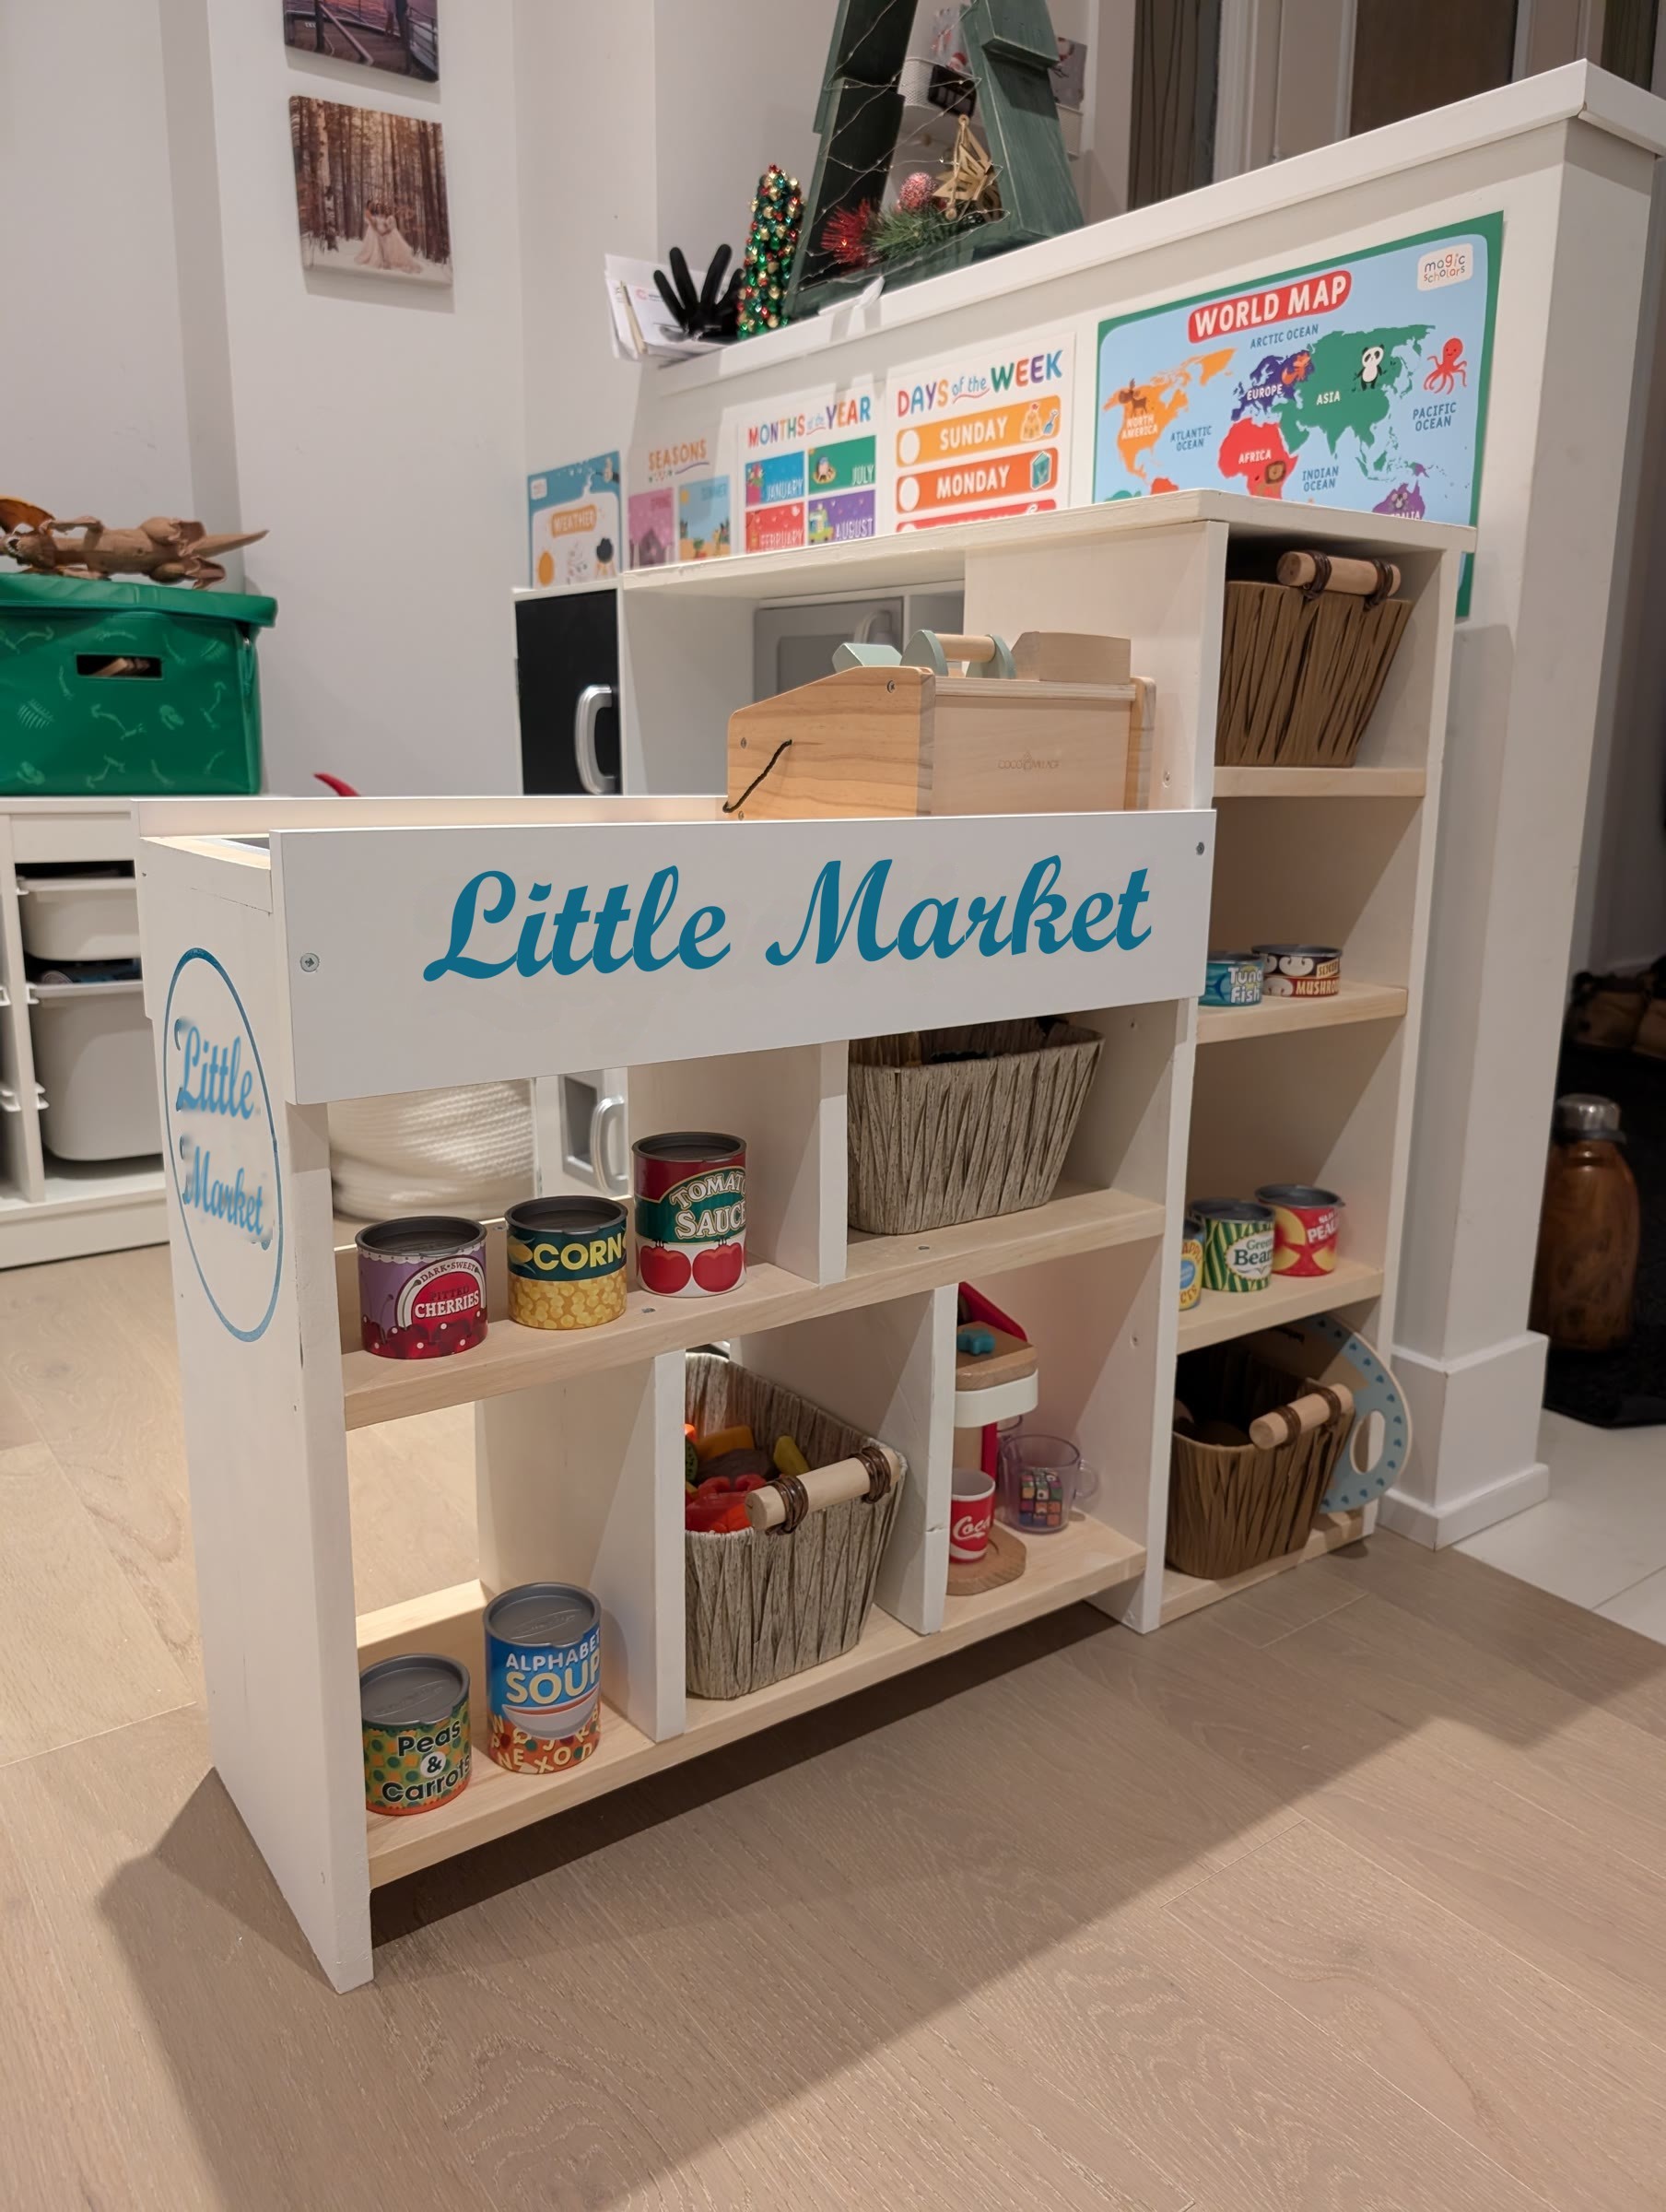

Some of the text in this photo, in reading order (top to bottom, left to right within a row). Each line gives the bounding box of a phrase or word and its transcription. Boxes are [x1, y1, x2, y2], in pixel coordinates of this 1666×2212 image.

[1425, 253, 1466, 273] magic
[1424, 265, 1465, 284] scholars
[1194, 275, 1347, 338] WORLD MAP
[1250, 324, 1319, 349] ARCTIC OCEAN
[897, 349, 1063, 418] DAYS of the WEEK
[1247, 383, 1284, 401] EUROPE
[1316, 390, 1341, 406] ASIA
[747, 414, 806, 448] MONTHS
[826, 395, 872, 429] YEAR
[1126, 414, 1156, 429] NORTH
[1413, 402, 1457, 420] PACIFIC
[938, 416, 1008, 452] SUNDAY
[1120, 424, 1158, 440] AMERICA
[1170, 425, 1213, 442] ATLANTIC
[1415, 415, 1452, 432] OCEAN
[649, 437, 708, 471] SEASONS
[1176, 438, 1205, 452] OCEAN
[1238, 449, 1272, 465] AFRICA
[851, 464, 875, 486] JULY
[936, 465, 1010, 499] MONDAY
[1302, 465, 1340, 482] INDIAN
[1303, 477, 1336, 492] OCEAN
[766, 478, 804, 502] JANUARY
[836, 517, 874, 540] AUGUST
[423, 854, 1153, 982] Little Market
[1230, 985, 1260, 1004] Fish
[181, 1025, 255, 1122] Little
[184, 1145, 264, 1236] Market
[533, 1232, 622, 1271] CORN
[420, 1261, 475, 1283] DARK SWEET
[415, 1289, 479, 1318] CHERRIES
[430, 1285, 470, 1301] PITTED
[397, 1720, 461, 1757] Peas
[427, 1754, 443, 1775] &
[381, 1755, 470, 1804] Carrots
